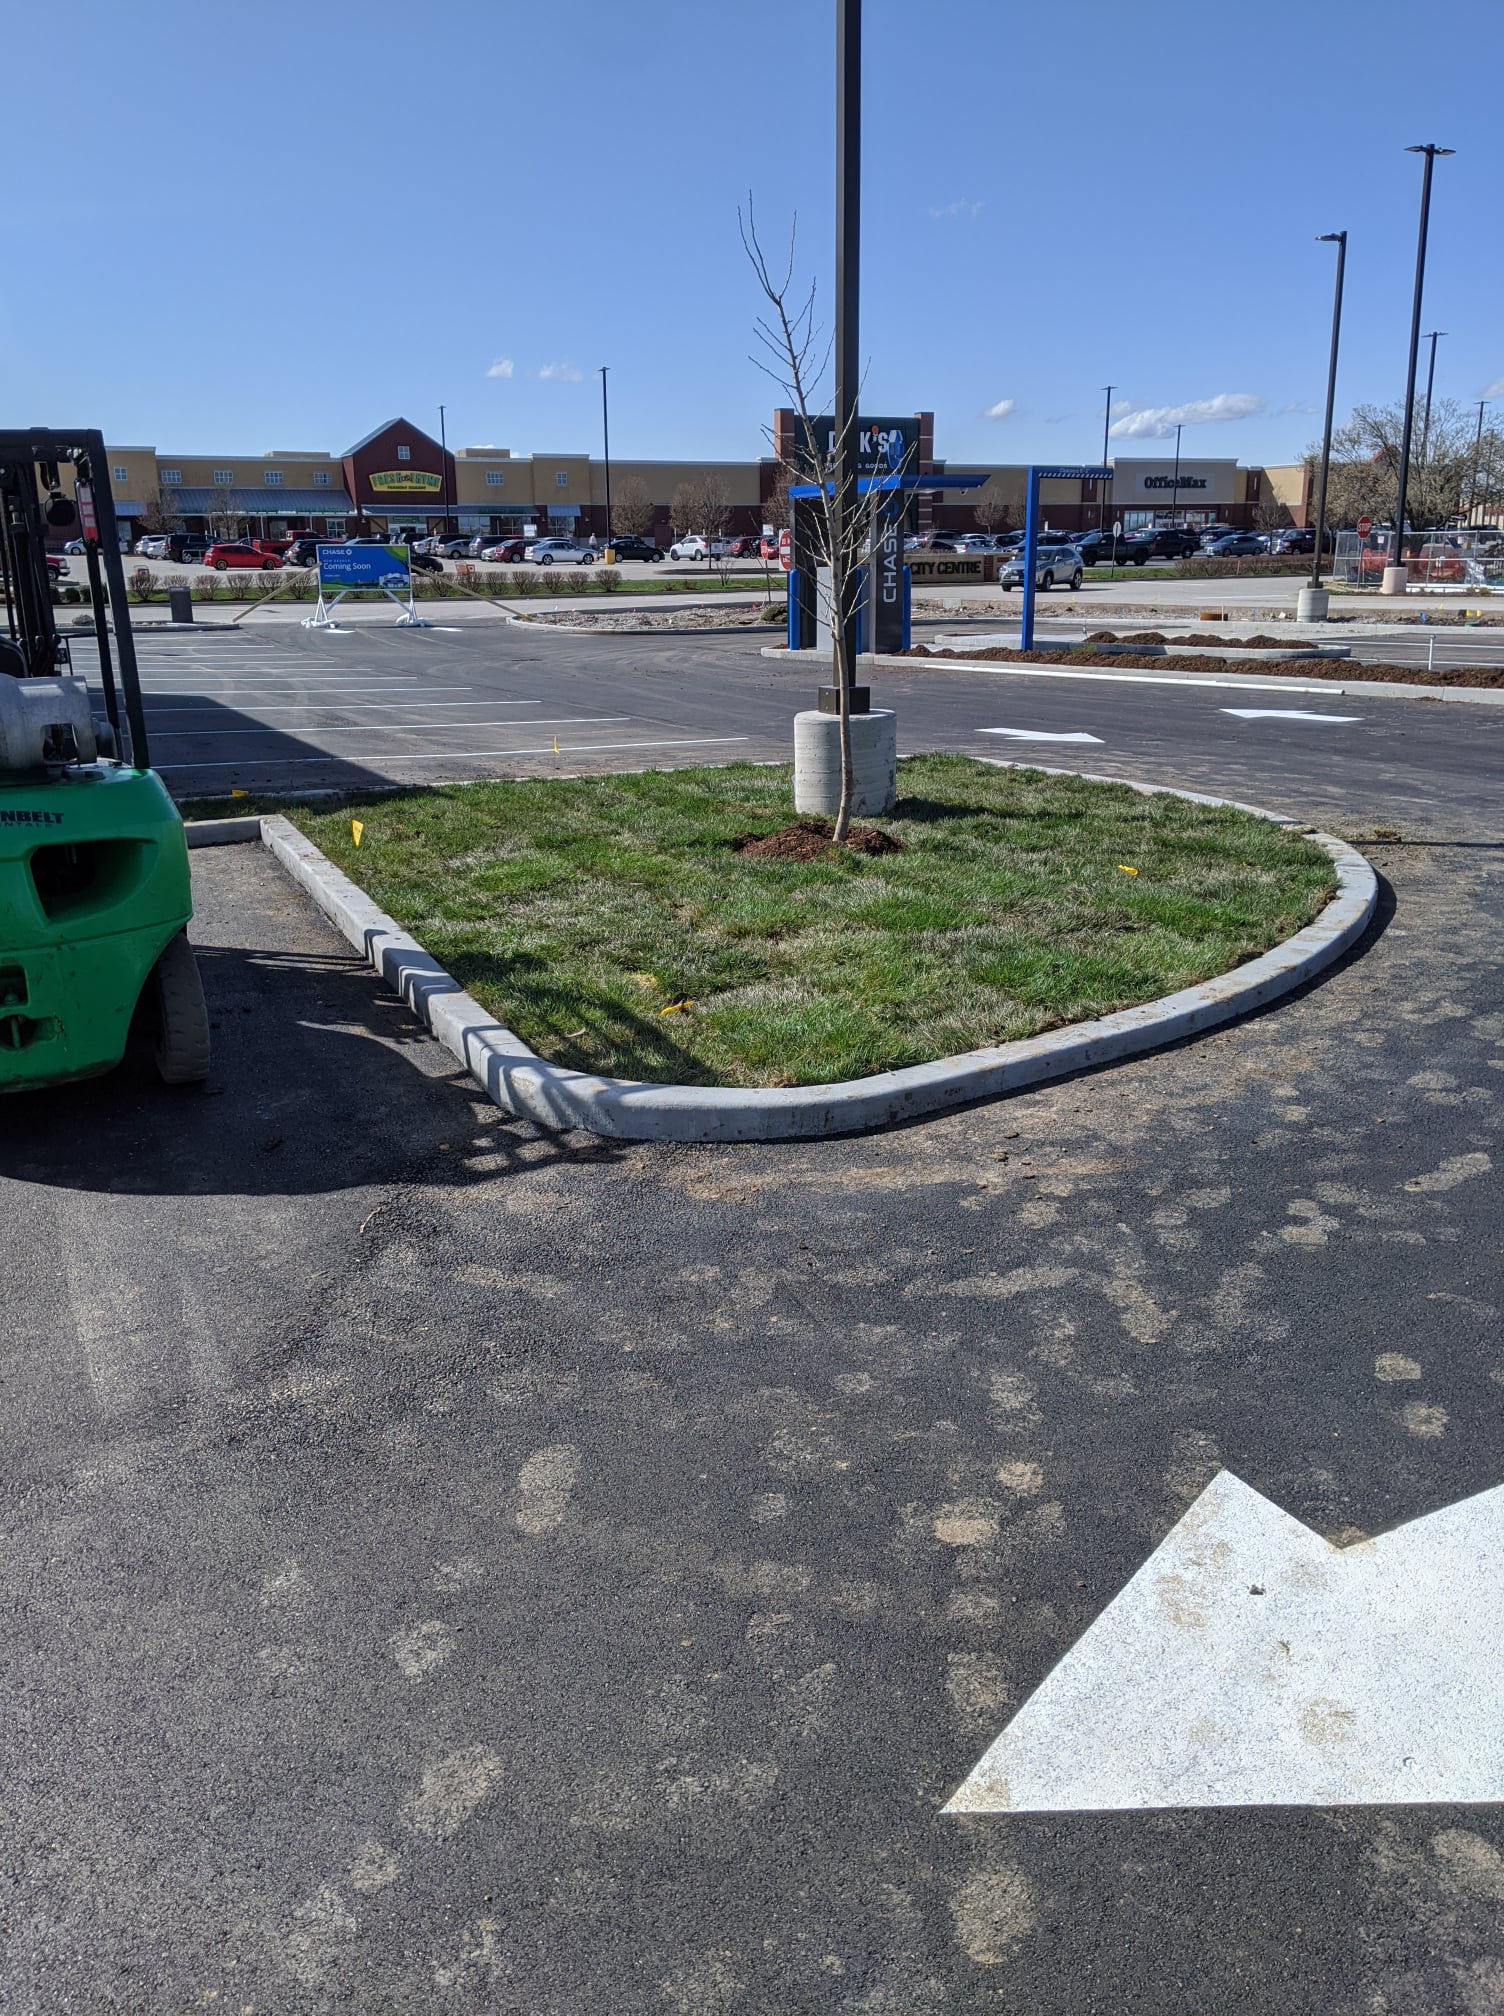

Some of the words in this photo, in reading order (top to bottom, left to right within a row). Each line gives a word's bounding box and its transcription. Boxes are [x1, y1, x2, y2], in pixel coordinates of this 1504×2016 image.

[828, 430, 888, 453] DK'S
[1144, 475, 1207, 489] OfficeMax
[1358, 523, 1371, 532] STOP
[323, 563, 351, 571] Coming
[883, 524, 897, 603] CHASE
[910, 562, 936, 575] CITY
[937, 561, 982, 574] CENTRE
